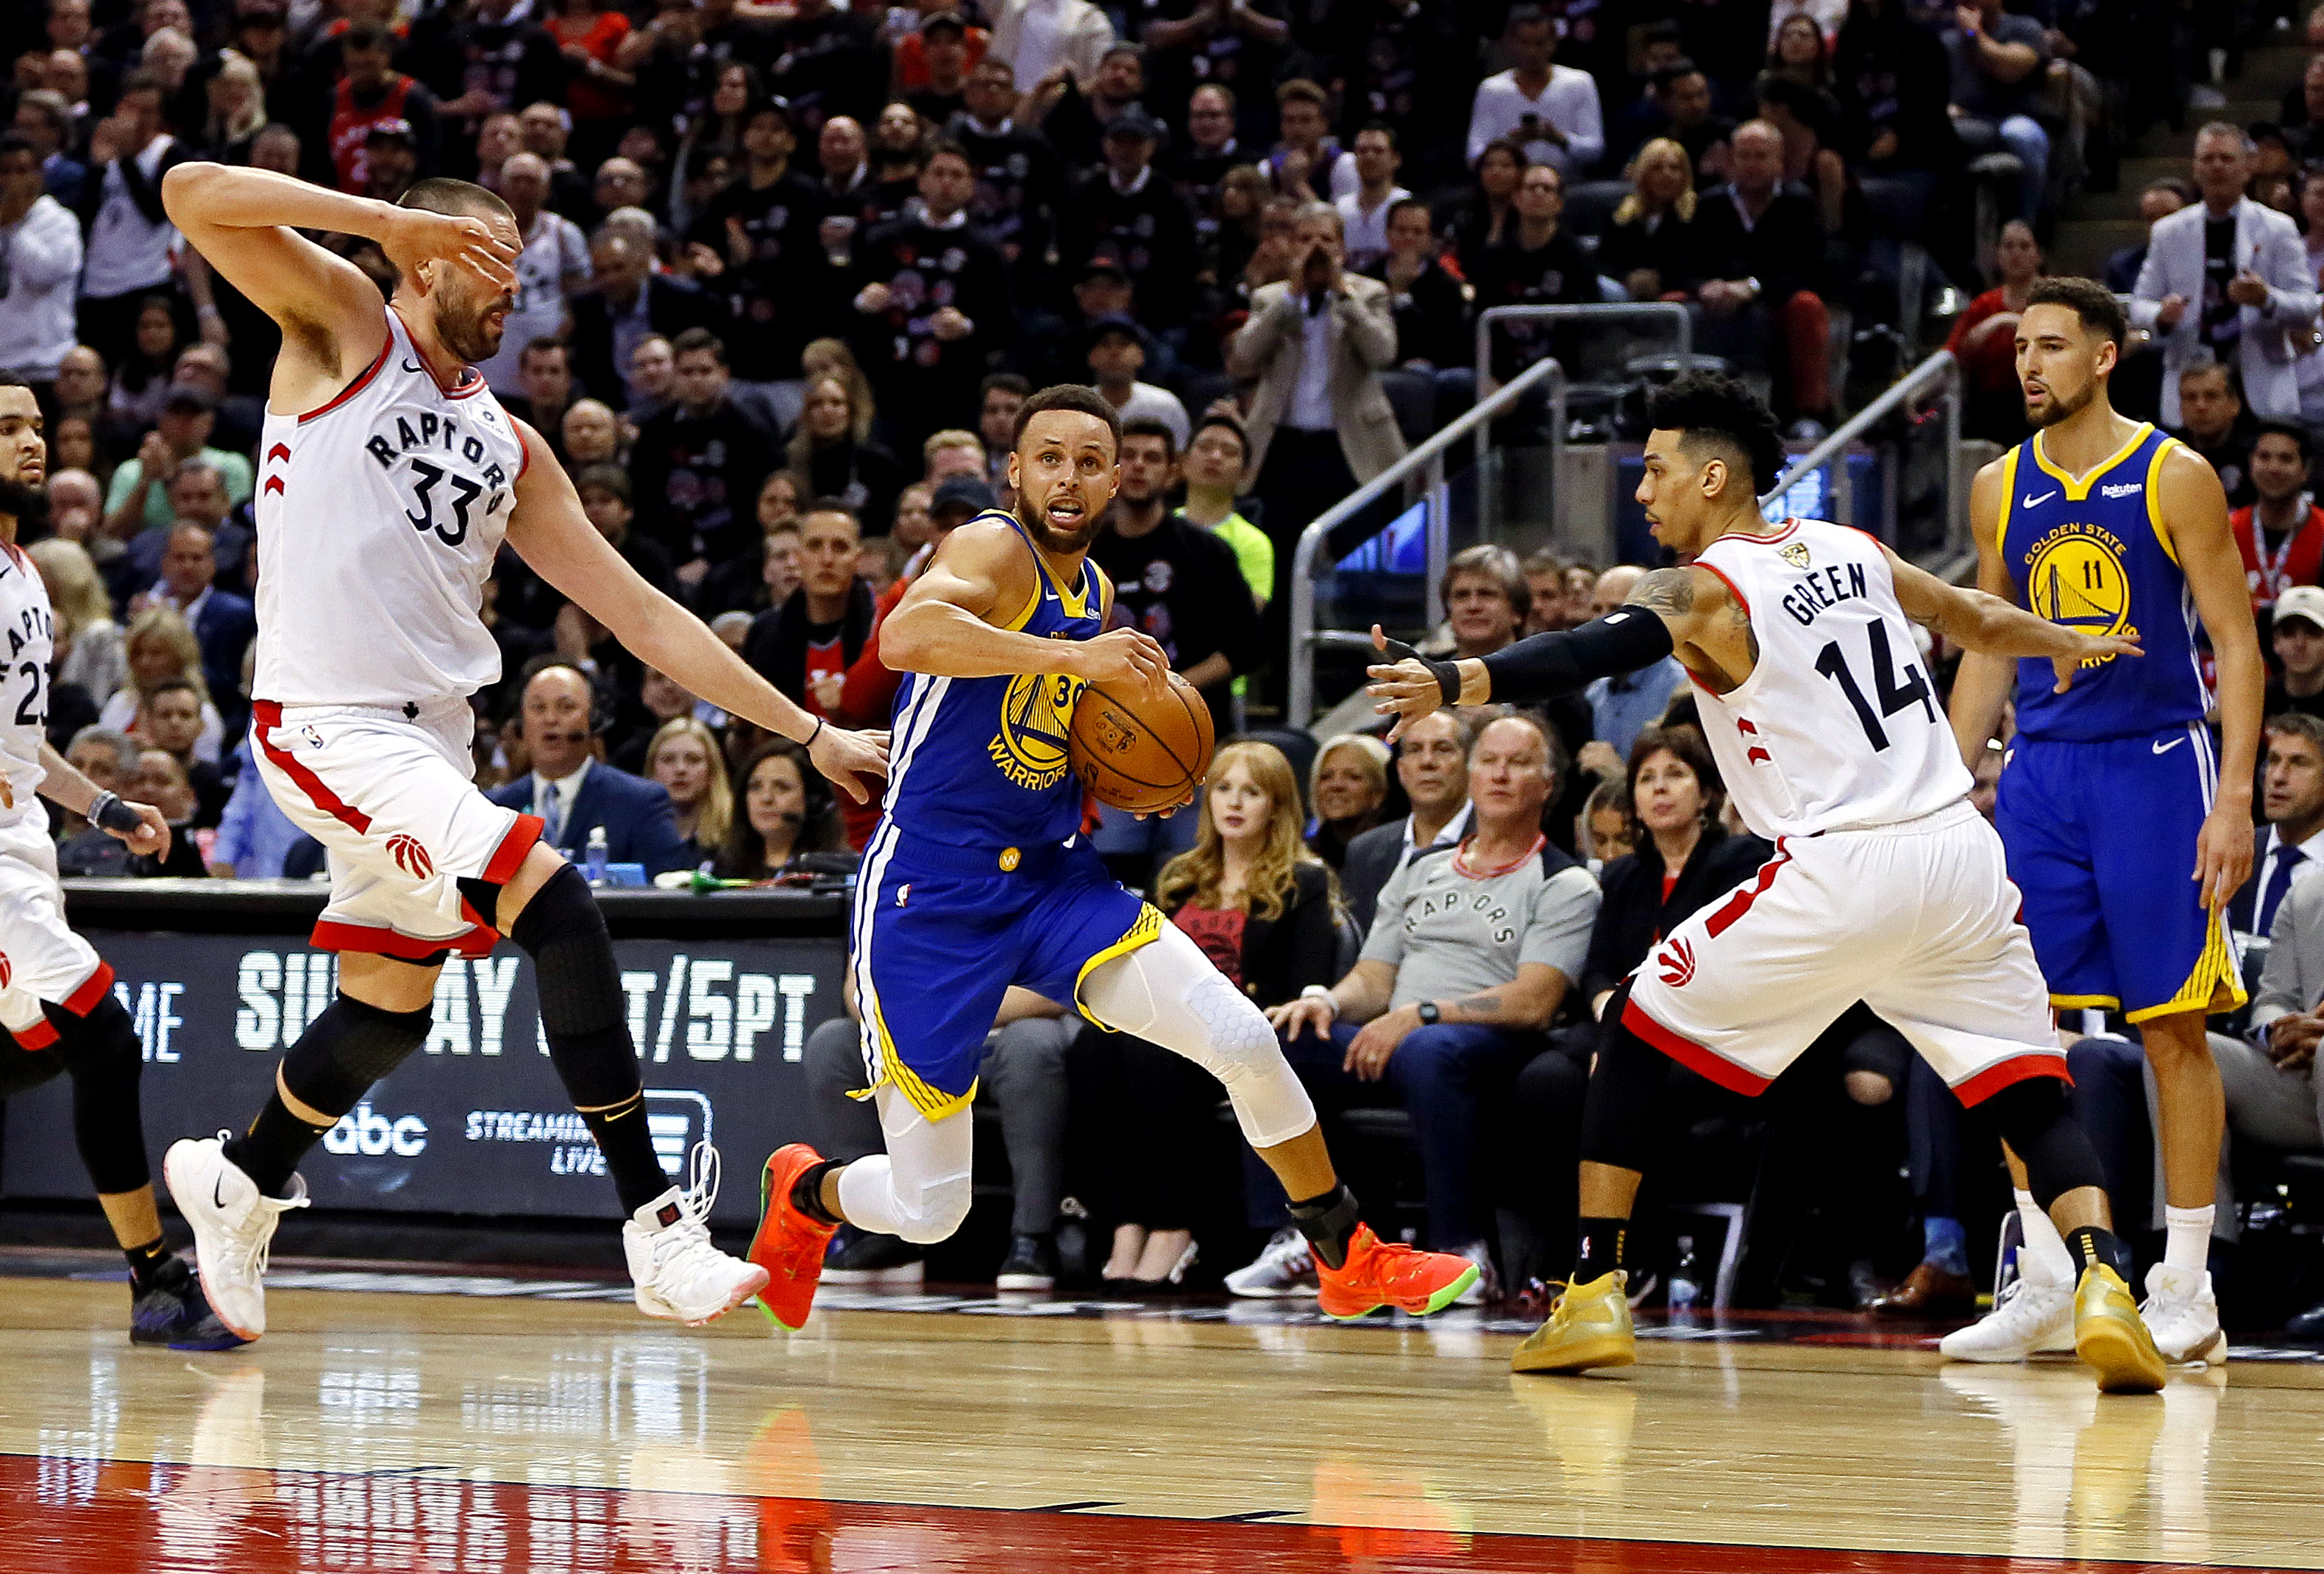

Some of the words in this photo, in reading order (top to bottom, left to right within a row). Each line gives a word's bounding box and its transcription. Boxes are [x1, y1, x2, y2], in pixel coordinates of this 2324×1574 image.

[364, 412, 505, 516] RAPTORS
[2102, 482, 2143, 497] Rakuten
[405, 457, 483, 546] 33
[2024, 521, 2080, 565] GOLDEN
[2085, 523, 2128, 556] STATE
[1783, 563, 1867, 627] GREEN
[2083, 560, 2103, 589] 11
[1814, 617, 1936, 752] 14
[987, 733, 1067, 791] WARRIOR
[234, 950, 520, 1056] SUAY
[322, 1101, 428, 1157] abc
[465, 1110, 593, 1143] STREAMIN
[550, 1144, 608, 1176] LIVE
